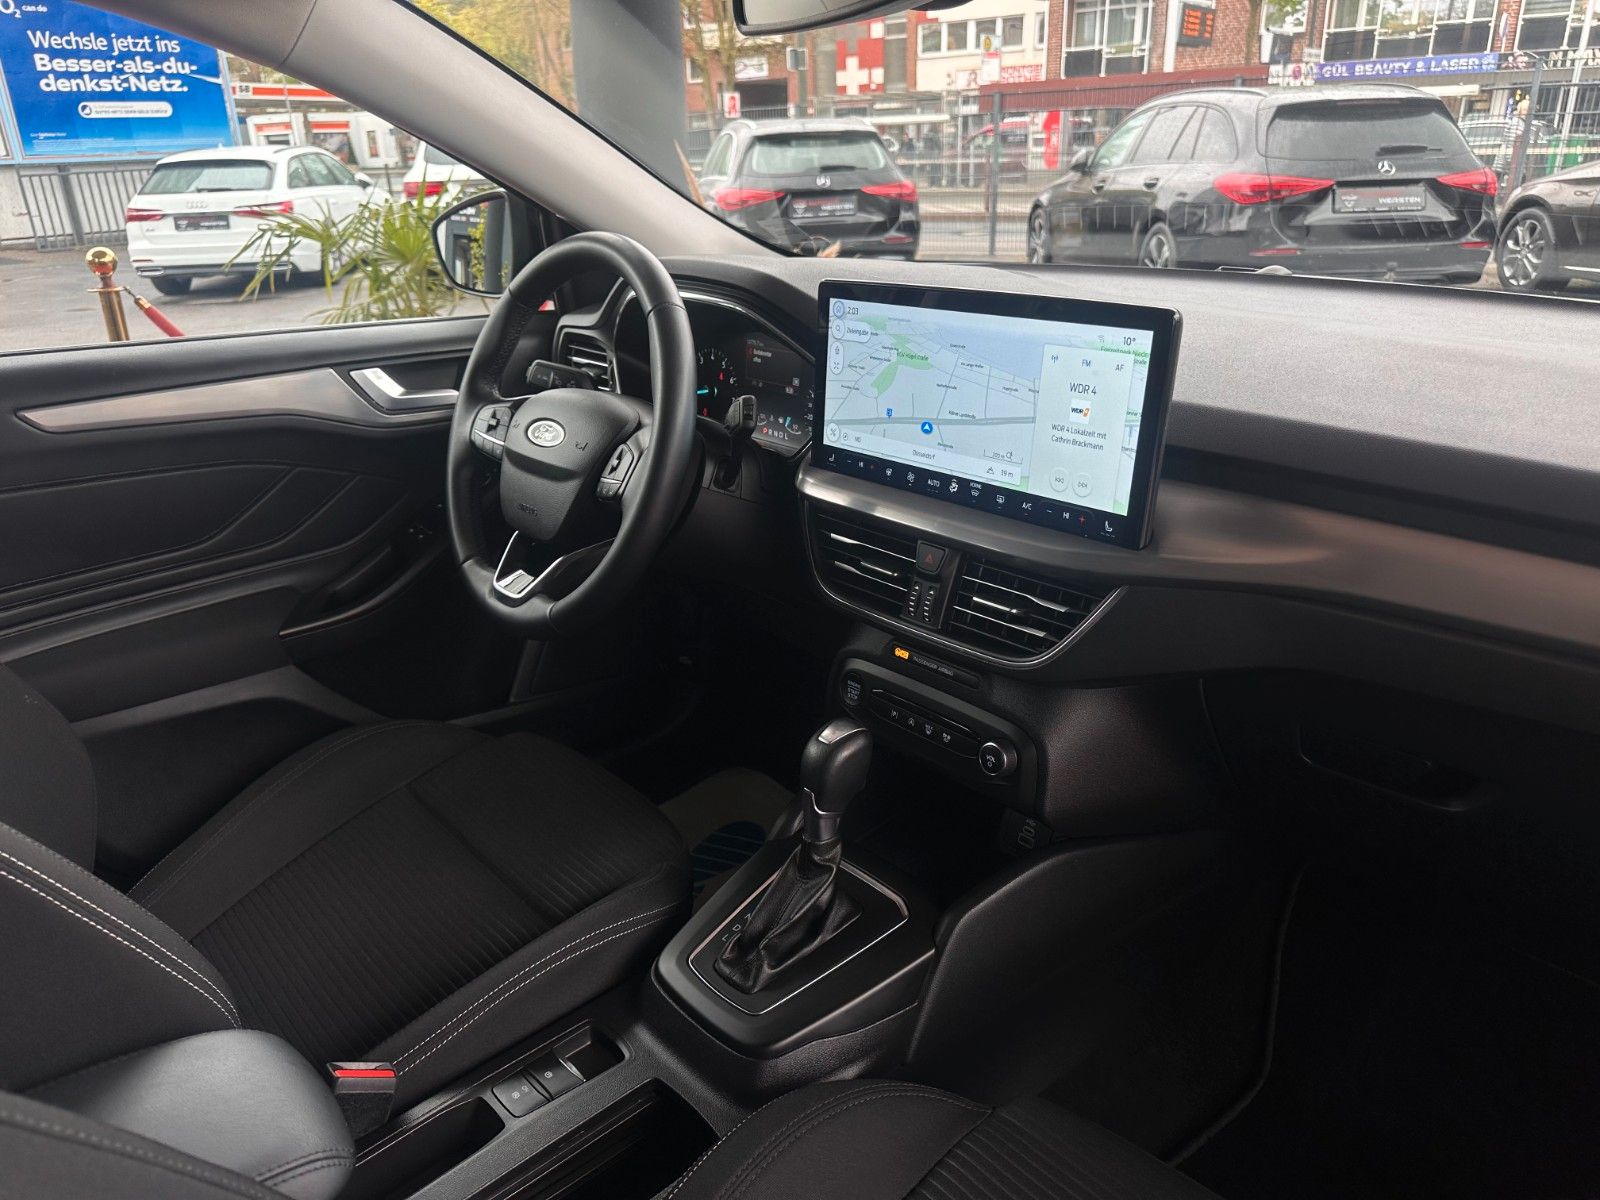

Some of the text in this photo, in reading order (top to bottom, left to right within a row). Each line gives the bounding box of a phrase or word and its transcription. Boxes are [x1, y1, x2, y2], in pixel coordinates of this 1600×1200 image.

[27, 30, 181, 56] Wechsle jetzt ins
[33, 53, 198, 74] Besser-als-du-
[1322, 62, 1349, 78] GÜL
[1354, 61, 1412, 76] BEAUTY
[1415, 61, 1426, 72] &
[1430, 57, 1480, 71] LASER
[39, 73, 189, 93] denkst-Netz.
[1081, 359, 1092, 368] FM
[1115, 364, 1125, 372] AF
[1070, 382, 1097, 395] WDR 4
[1051, 423, 1066, 432] WDR
[1070, 428, 1096, 438] Lokalzeit
[1096, 432, 1107, 440] mit
[1051, 435, 1104, 450] Cathrin Brackmann
[927, 478, 941, 488] AUTO
[1021, 502, 1032, 511] A/C
